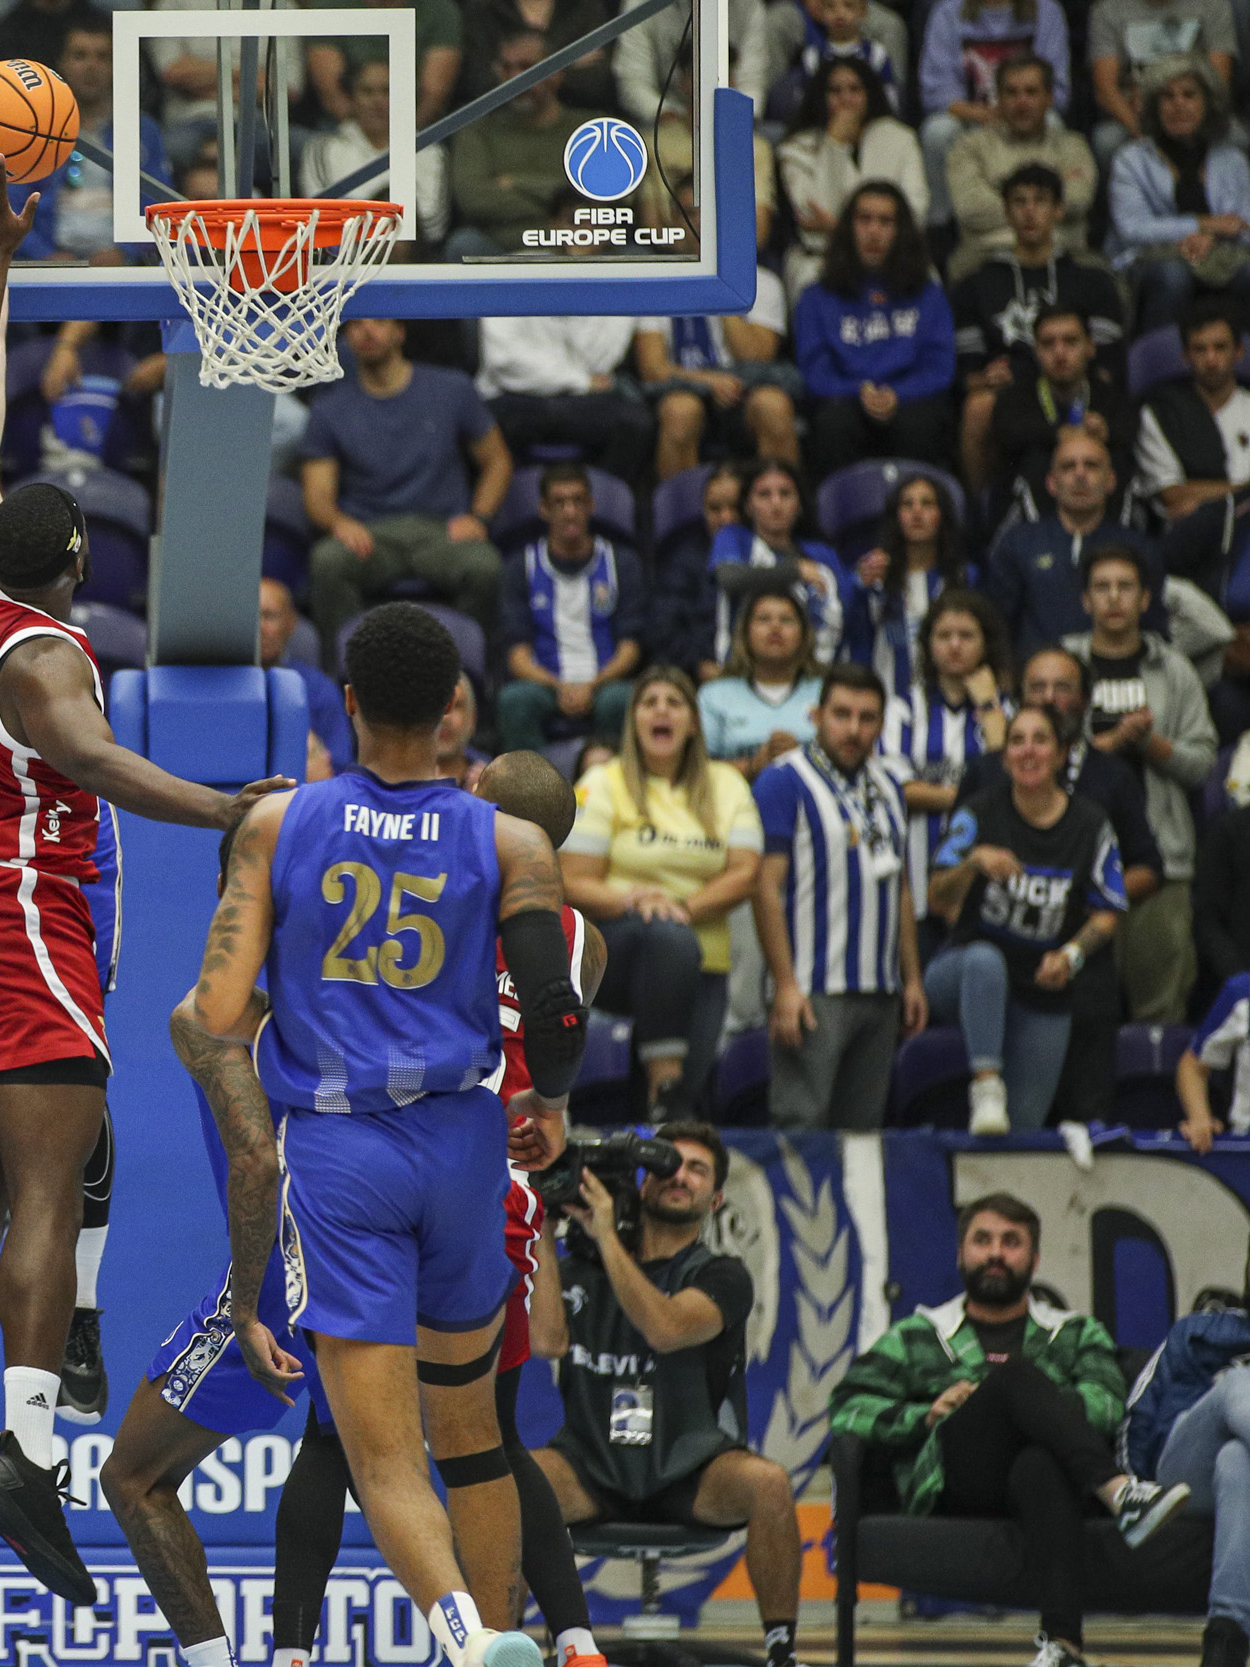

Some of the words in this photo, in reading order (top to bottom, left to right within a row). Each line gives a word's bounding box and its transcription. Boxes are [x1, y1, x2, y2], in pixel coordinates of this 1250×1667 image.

[573, 207, 634, 225] FIBA
[521, 228, 627, 247] EUROPE
[633, 227, 686, 245] CUP
[344, 804, 416, 840] FAYNE
[420, 811, 440, 841] II
[321, 860, 448, 990] 25
[26, 1400, 50, 1410] adidas
